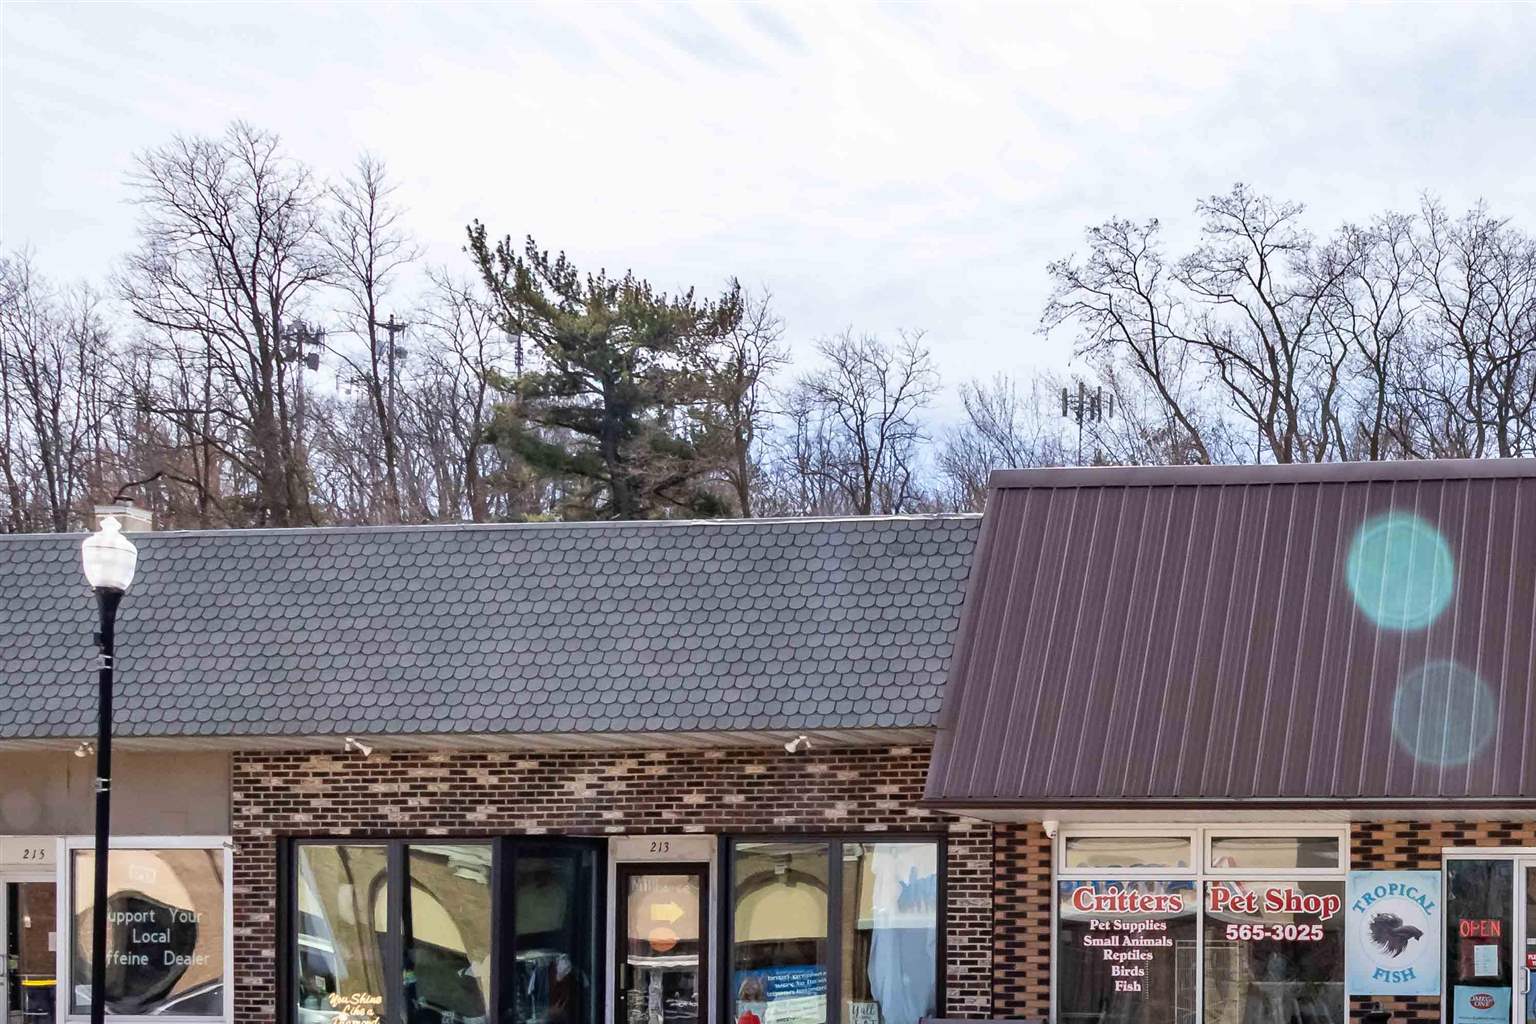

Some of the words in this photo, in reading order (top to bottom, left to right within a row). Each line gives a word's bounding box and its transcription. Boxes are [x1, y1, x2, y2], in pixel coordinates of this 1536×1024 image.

[22, 848, 46, 860] 215
[650, 841, 670, 853] 213
[1072, 885, 1184, 913] Critters
[1209, 886, 1259, 914] Pet
[1263, 887, 1341, 921] Shop
[1352, 883, 1436, 916] TROPICAL
[107, 909, 156, 927] upport
[169, 908, 202, 923] Your
[1090, 919, 1111, 931] Pet
[1113, 919, 1167, 933] Supplies
[1225, 924, 1324, 941] 565-3025
[1459, 919, 1501, 938] OPEN
[132, 928, 171, 944] Local
[1083, 935, 1120, 947] Small
[1122, 935, 1173, 947] Animals
[105, 950, 150, 968] ffeine
[164, 950, 209, 966] Dealer
[1103, 949, 1154, 962] Reptiles
[1111, 965, 1145, 977] Birds
[1372, 966, 1417, 984] FISH
[1115, 980, 1142, 992] Fish
